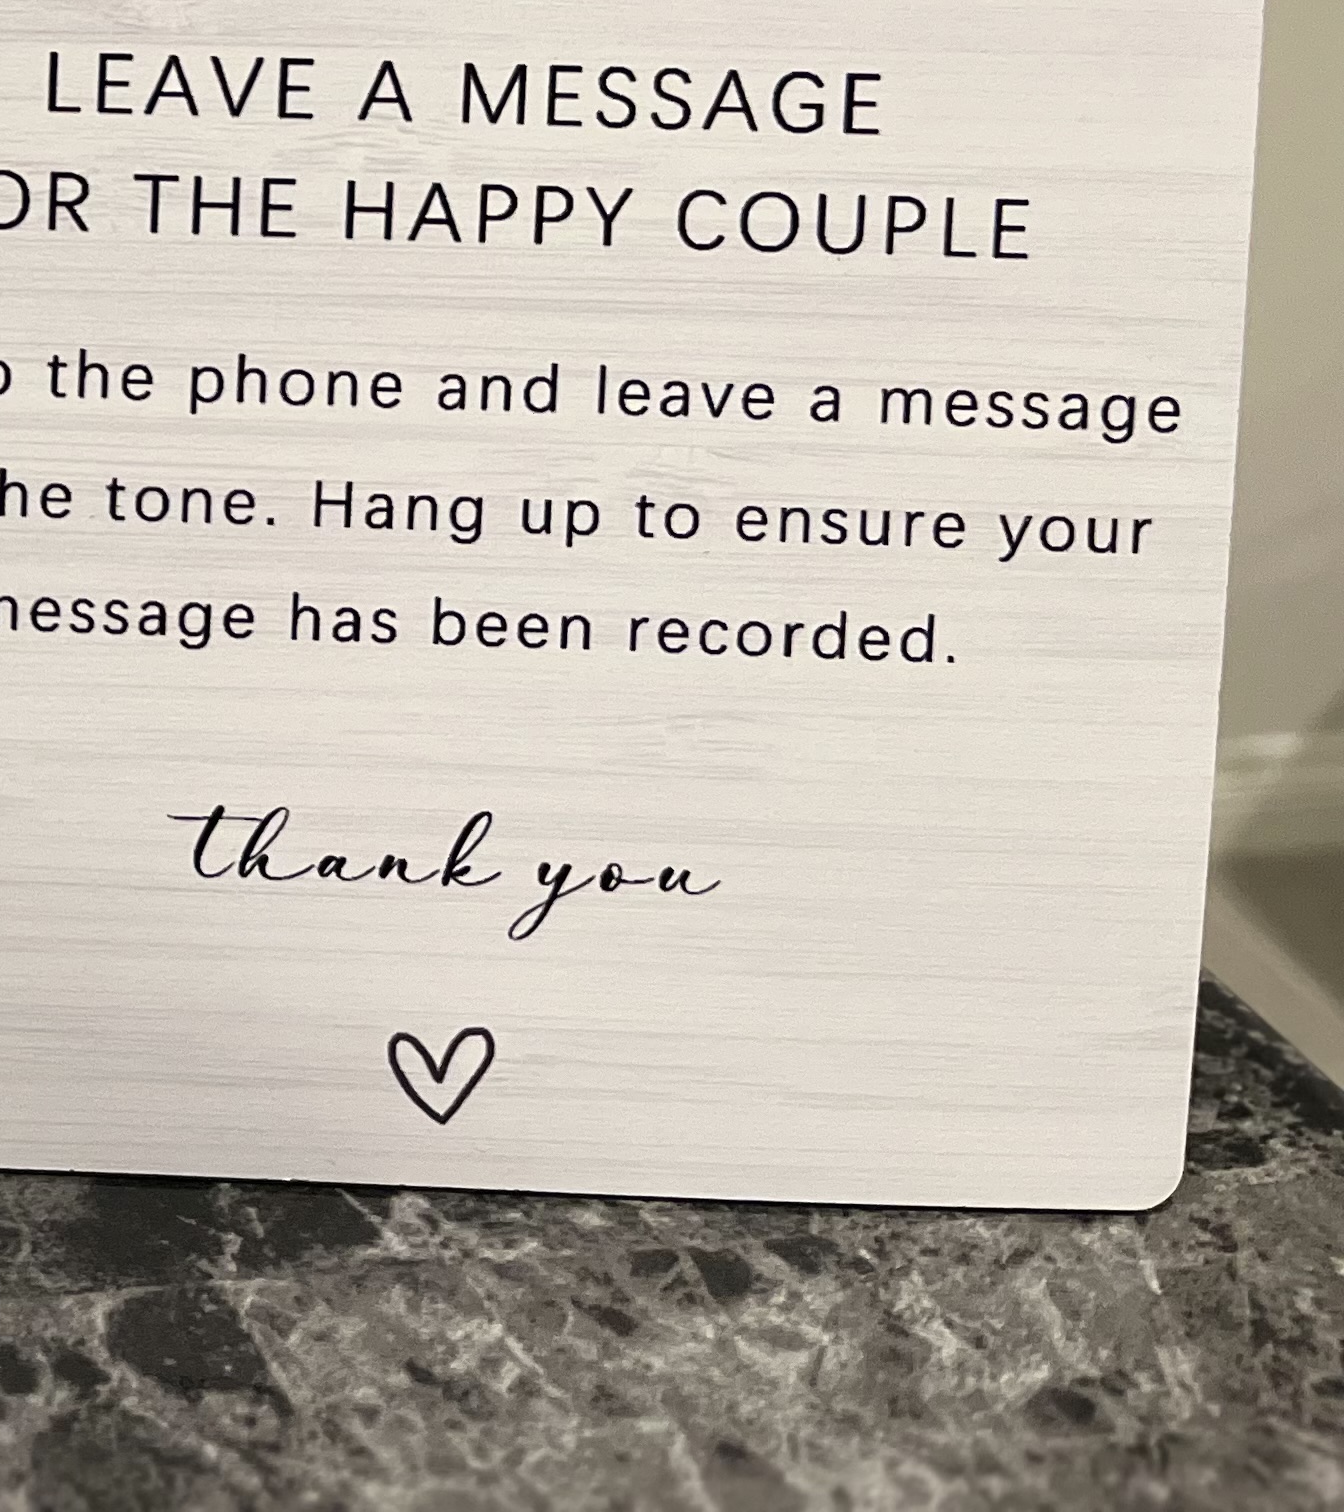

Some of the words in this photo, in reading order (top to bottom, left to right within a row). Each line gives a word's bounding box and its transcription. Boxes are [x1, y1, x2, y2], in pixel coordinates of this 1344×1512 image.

[46, 50, 316, 121] LEAVE
[357, 59, 414, 123] A
[461, 61, 882, 136] MESSAGE
[132, 172, 298, 239] THE
[344, 179, 634, 248] HAPPY
[677, 188, 1031, 261] COUPLE
[46, 347, 155, 402] the
[189, 352, 403, 416] phone
[437, 362, 560, 415] and
[597, 363, 776, 421] leave
[809, 384, 841, 423] a
[880, 386, 1182, 445] message
[105, 476, 280, 528] tone.
[313, 479, 484, 546] Hang
[521, 497, 601, 549] up
[635, 494, 701, 540] to
[735, 504, 966, 550] ensure
[998, 513, 1153, 564] your
[290, 590, 398, 645] has
[431, 595, 592, 651] been
[628, 609, 958, 666] recorded.
[167, 804, 500, 888] thank
[507, 861, 721, 942] you
